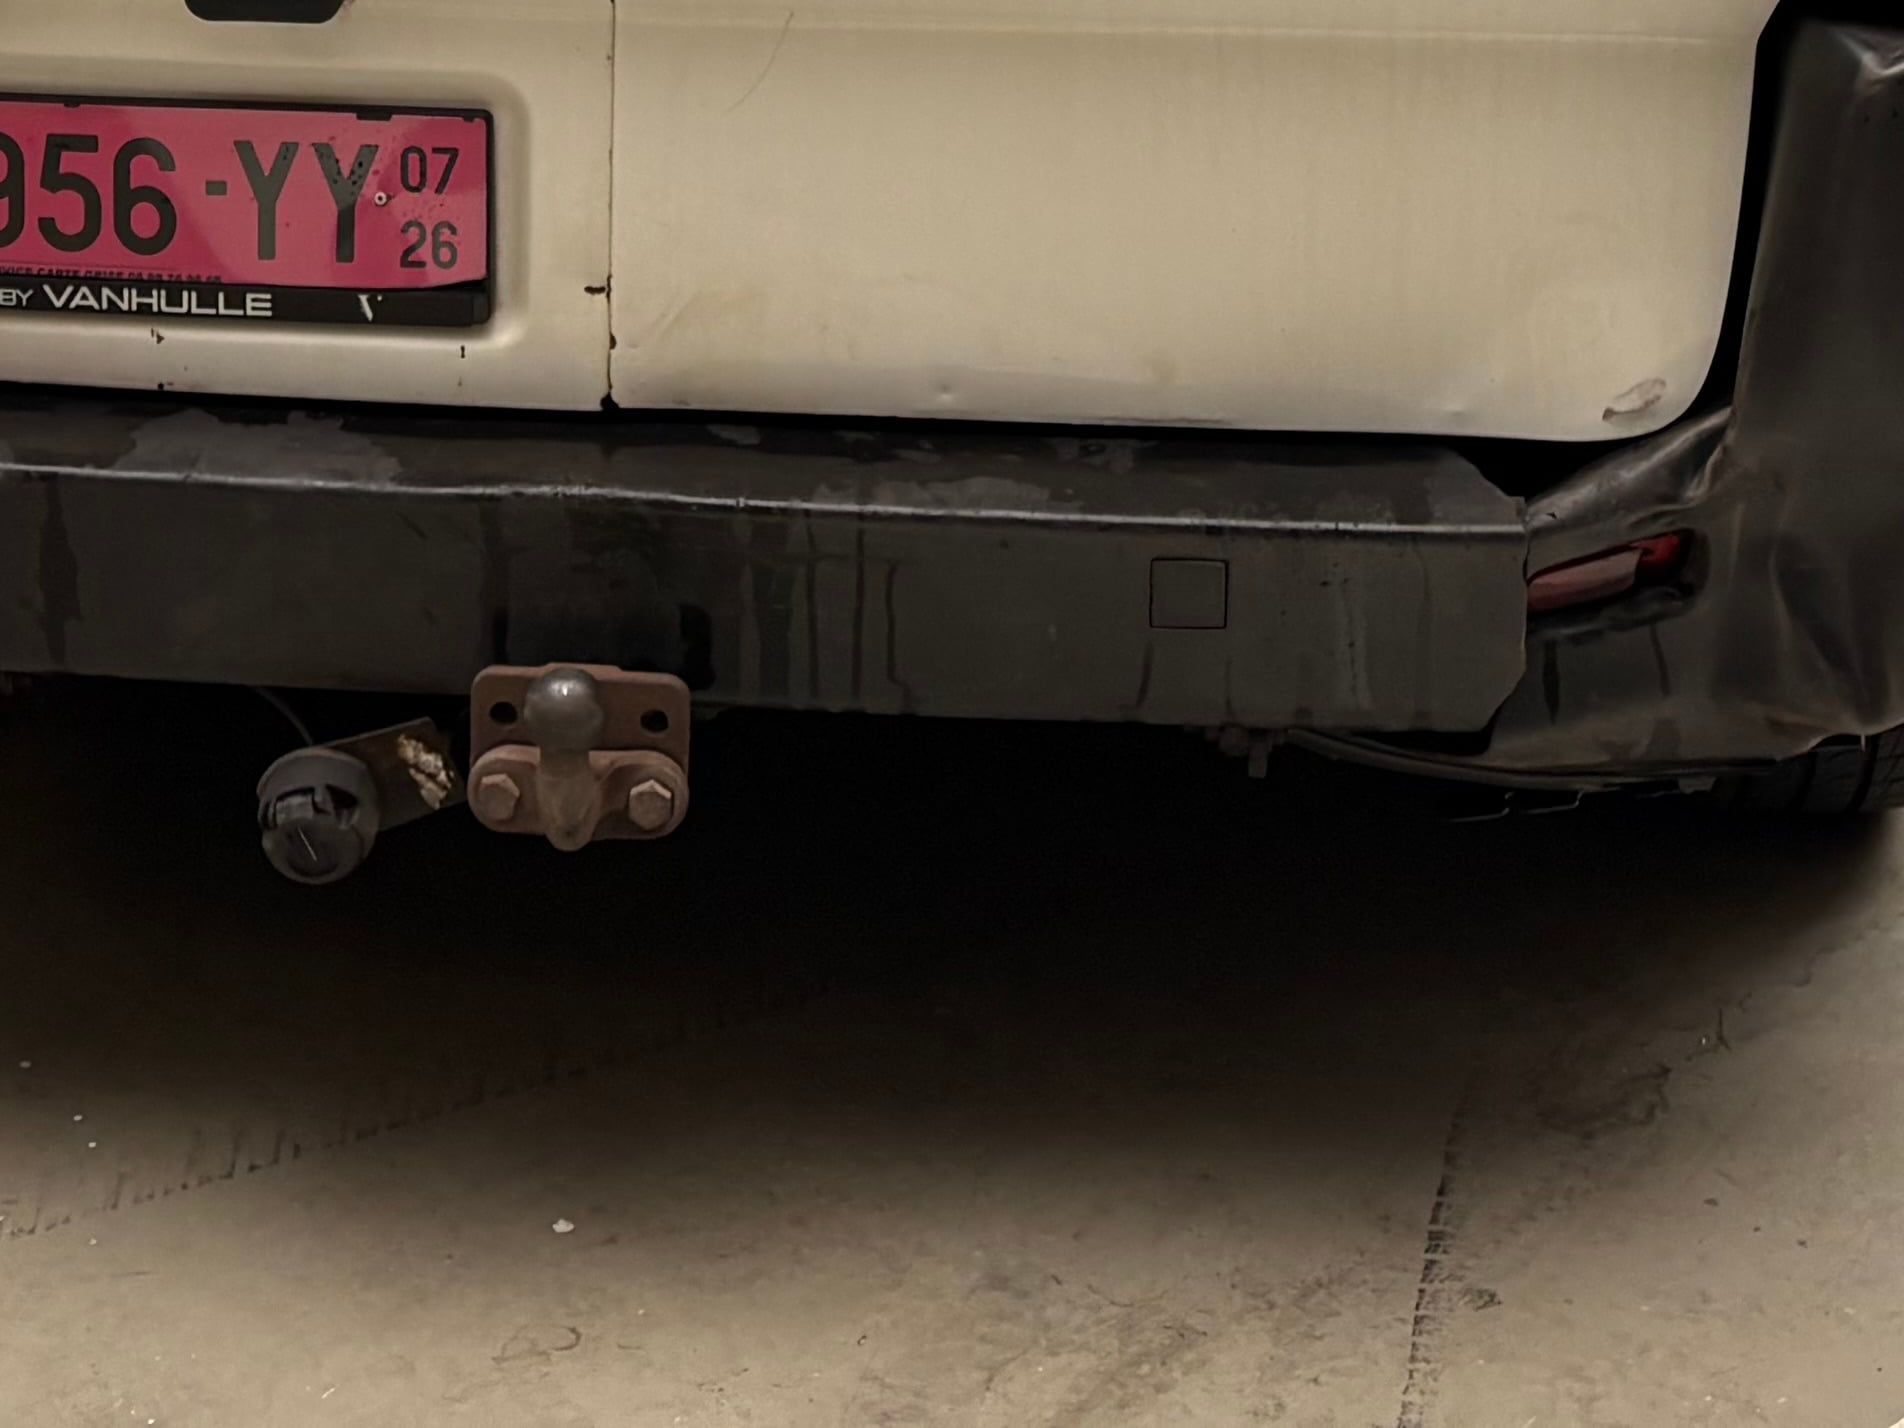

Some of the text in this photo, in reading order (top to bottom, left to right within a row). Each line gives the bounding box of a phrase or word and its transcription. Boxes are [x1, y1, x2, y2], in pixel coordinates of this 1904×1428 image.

[399, 146, 460, 194] 07
[399, 220, 459, 270] 26
[0, 288, 33, 306] BY
[42, 284, 272, 317] VANHULLE
